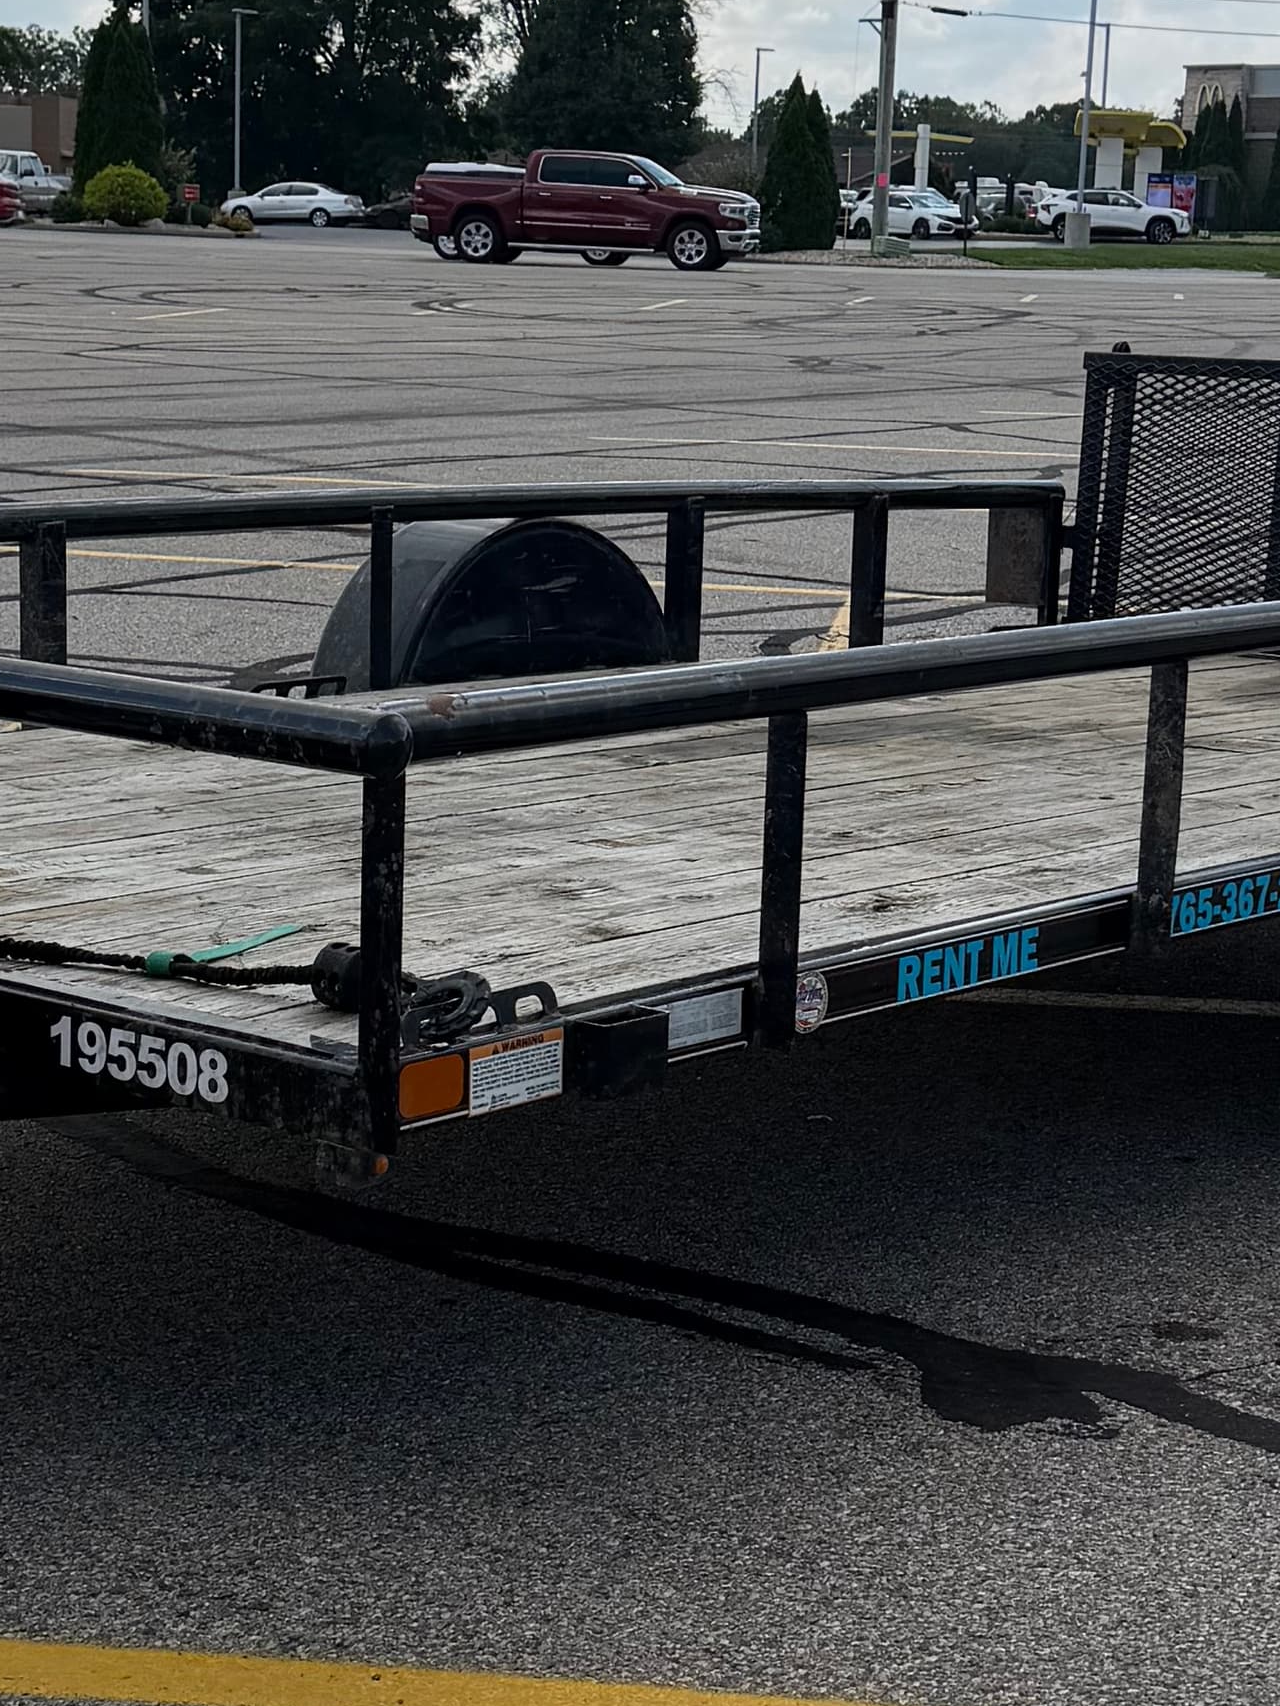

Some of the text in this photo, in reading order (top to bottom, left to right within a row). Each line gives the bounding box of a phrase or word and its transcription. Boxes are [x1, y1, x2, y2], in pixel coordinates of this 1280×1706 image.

[896, 939, 985, 1005] RENT
[991, 926, 1040, 980] ME
[49, 1015, 229, 1104] 195508
[501, 1033, 545, 1054] WARNING
